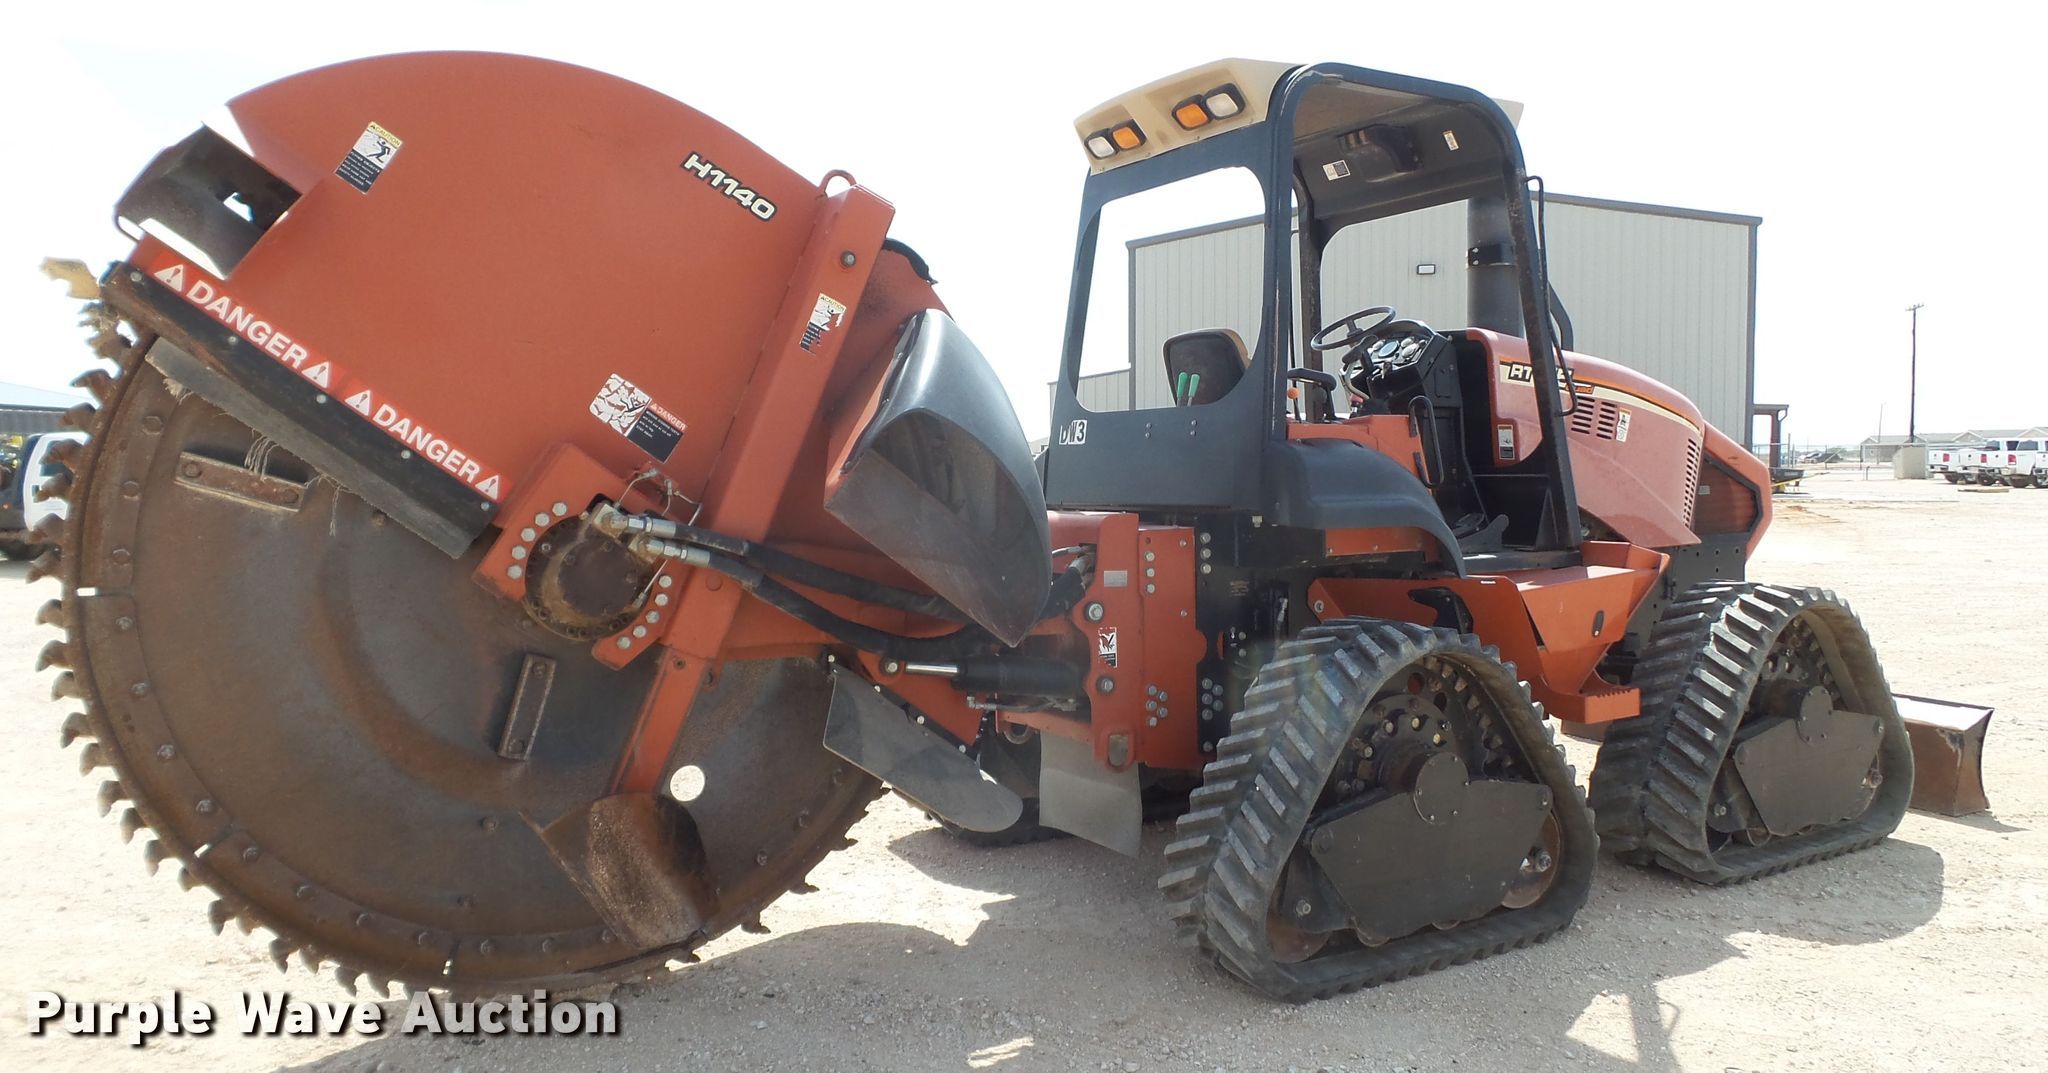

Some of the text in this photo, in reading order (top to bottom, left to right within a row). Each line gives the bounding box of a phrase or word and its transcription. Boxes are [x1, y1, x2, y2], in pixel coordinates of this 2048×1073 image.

[683, 153, 776, 220] H1140
[186, 280, 308, 369] DANGER
[372, 404, 480, 483] DANGER
[656, 406, 687, 431] DANGER
